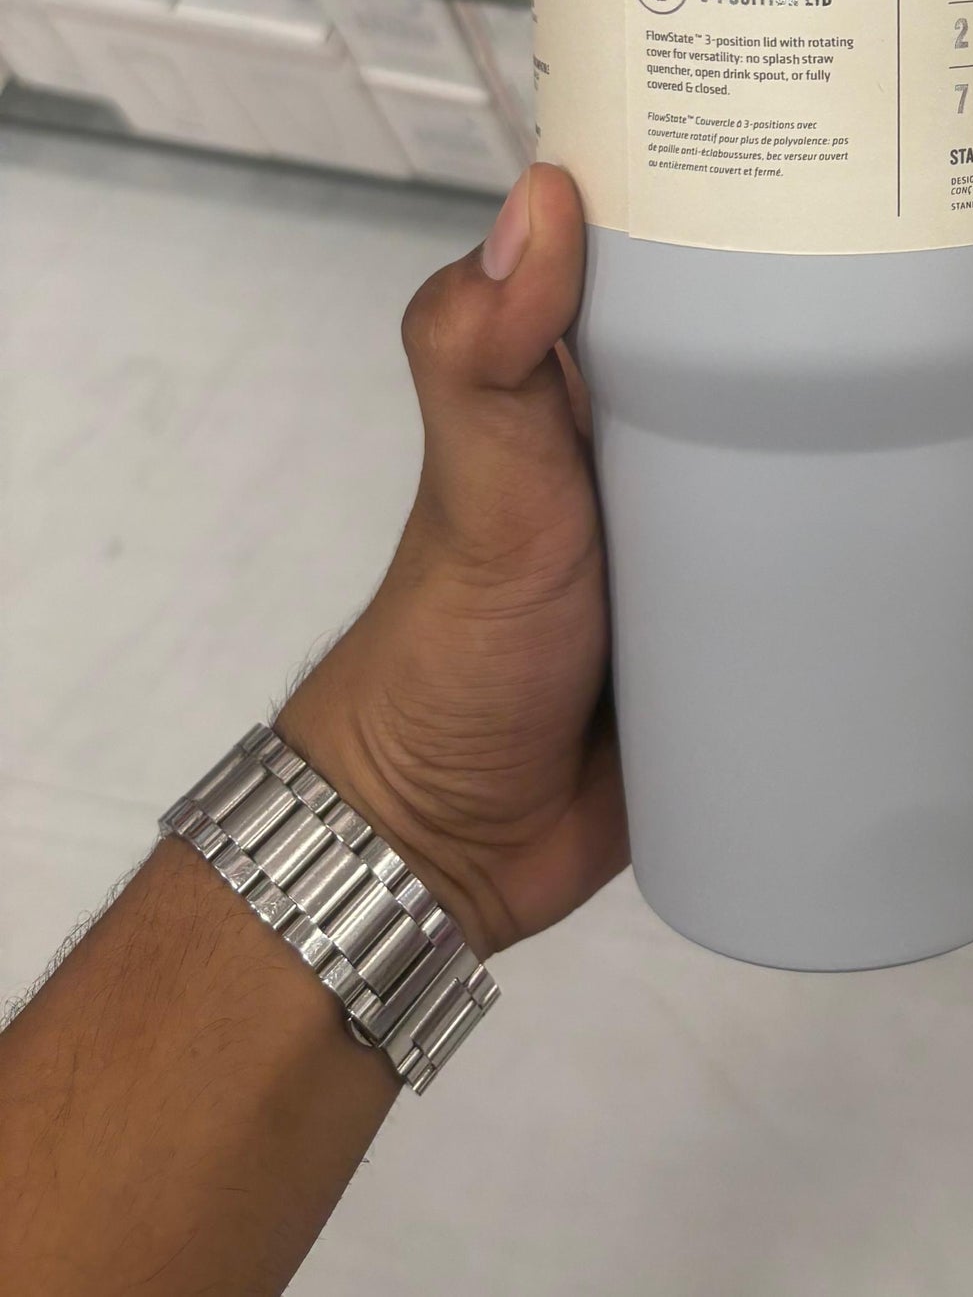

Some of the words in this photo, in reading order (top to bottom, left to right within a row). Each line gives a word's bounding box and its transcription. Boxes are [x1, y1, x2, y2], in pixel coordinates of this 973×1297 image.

[705, 34, 761, 48] 3-position
[763, 36, 777, 48] lid
[779, 36, 805, 48] with
[807, 37, 854, 50] rotating
[954, 17, 969, 49] 2
[646, 47, 671, 58] cover
[673, 48, 687, 60] for
[688, 50, 744, 65] versatility:
[746, 55, 760, 64] no
[762, 53, 800, 66] splash
[801, 54, 834, 64] straw
[647, 63, 693, 77] quencher,
[695, 68, 721, 80] open
[723, 68, 750, 80] drink
[753, 70, 789, 83] spout,
[791, 71, 803, 80] or
[805, 69, 831, 83] fully
[647, 80, 683, 92] covered
[685, 82, 693, 93] &
[695, 83, 730, 96] closed.
[954, 83, 969, 114] 7
[695, 116, 735, 128] Couvercle
[743, 119, 795, 130] 3-positions
[796, 121, 817, 130] avec
[647, 127, 689, 140] couverture
[689, 133, 717, 145] rotatif
[718, 135, 739, 145] pour
[740, 135, 759, 146] plus
[760, 136, 772, 146] de
[773, 136, 830, 147] polyvalence:
[831, 137, 849, 147] pas
[648, 142, 657, 152] de
[658, 144, 680, 155] paille
[766, 151, 782, 161] bec
[784, 152, 817, 161] verseur
[818, 151, 849, 161] ouvert
[648, 158, 658, 168] ou
[658, 159, 708, 173] entièrement
[709, 165, 742, 175] couvert
[743, 167, 752, 176] et
[753, 166, 784, 178] fermé.
